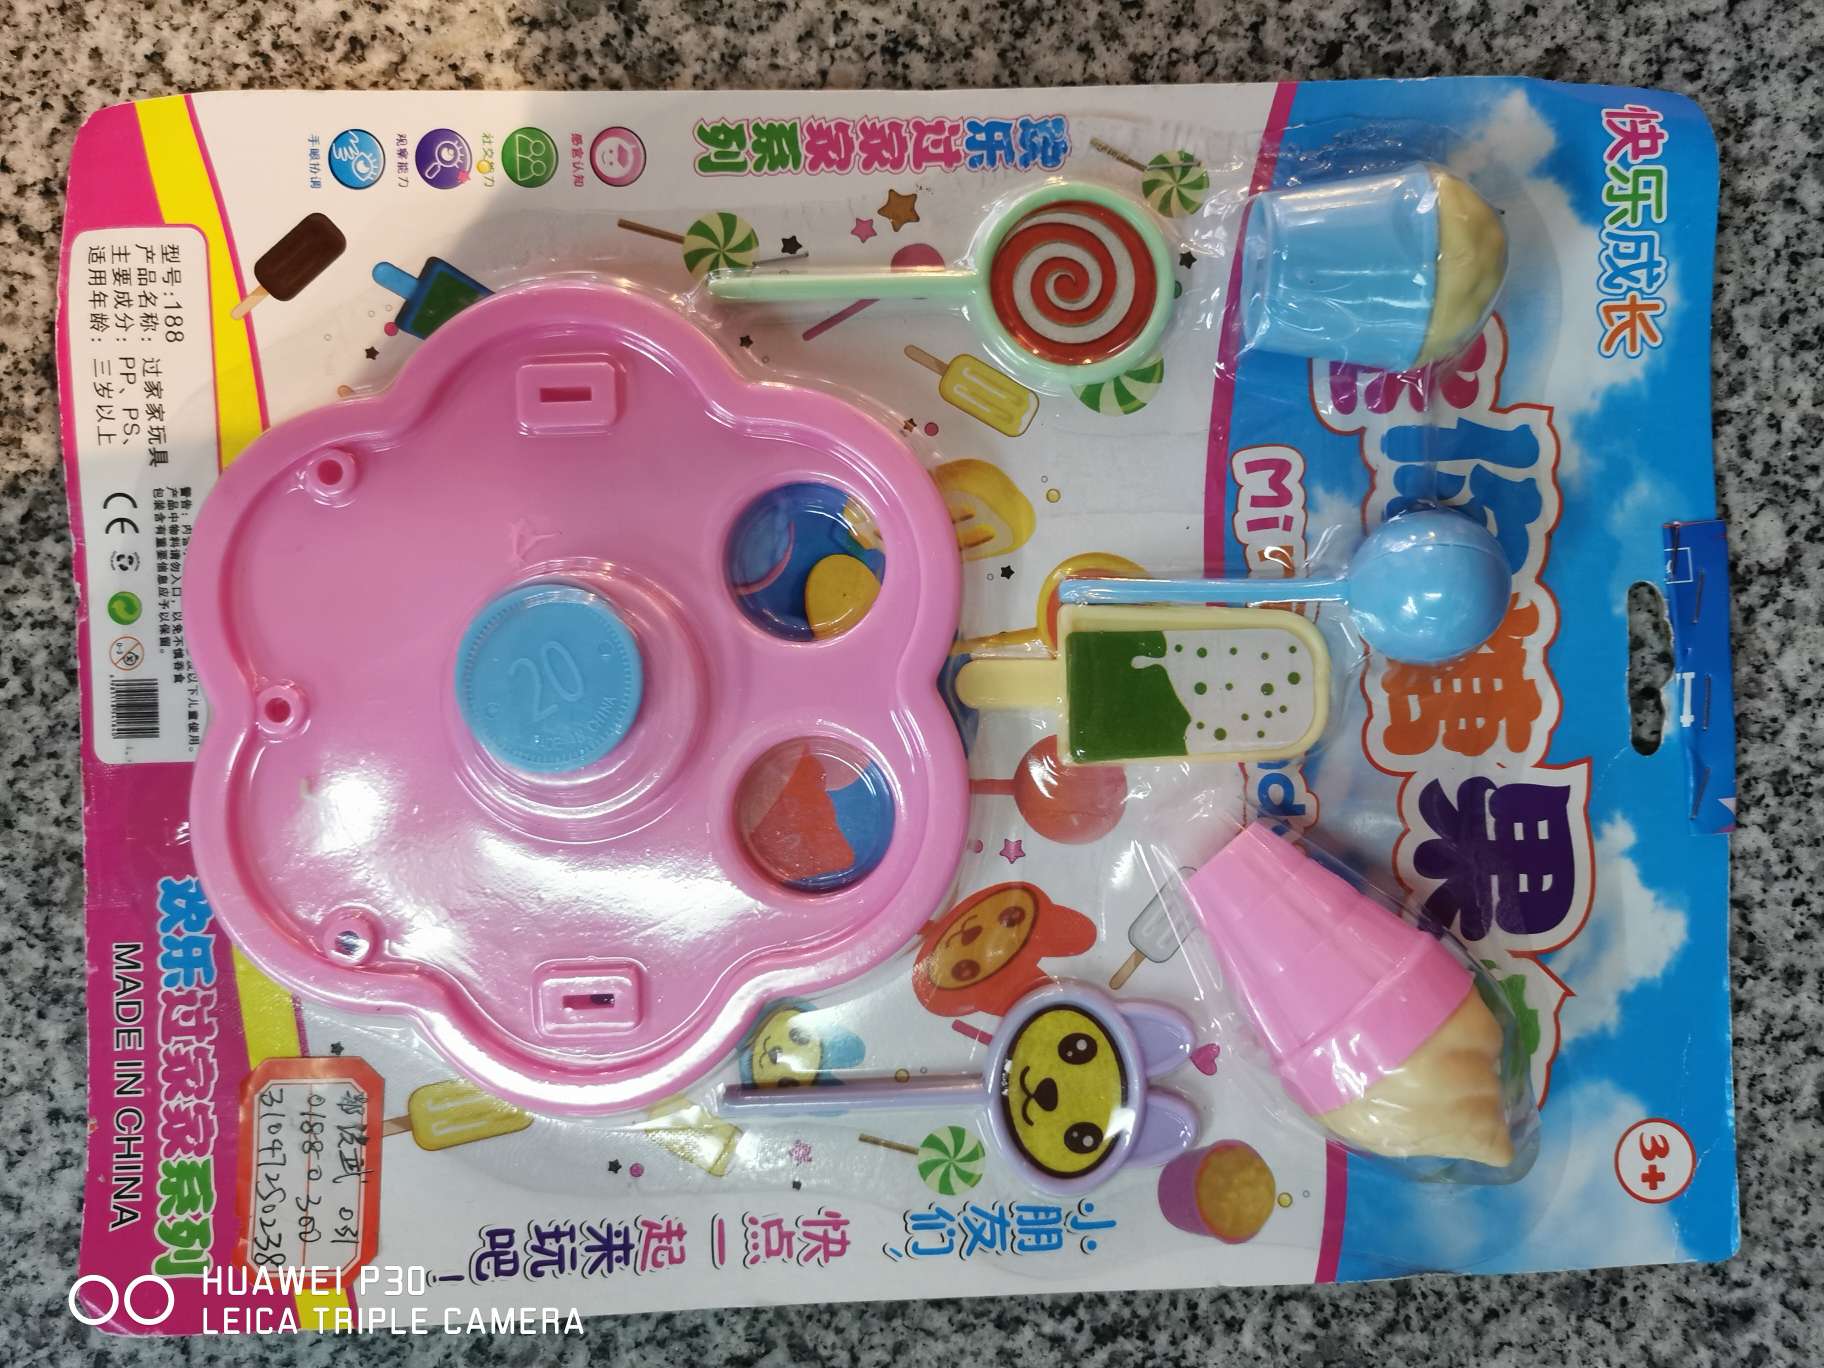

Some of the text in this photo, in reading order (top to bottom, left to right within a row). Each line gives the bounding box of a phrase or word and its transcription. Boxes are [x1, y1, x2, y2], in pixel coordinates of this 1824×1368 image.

[308, 134, 322, 189] 手眼协调
[694, 116, 1071, 176] 欢乐过家家系列
[1599, 105, 1669, 356] 快乐成长
[92, 358, 117, 446] 三岁以上
[142, 358, 169, 468] 过家家玩具
[508, 641, 585, 721] 20
[109, 943, 144, 1232] MADE IN CHINA
[152, 877, 219, 1279] 欢乐过家家系列
[1639, 1132, 1670, 1191] 3+
